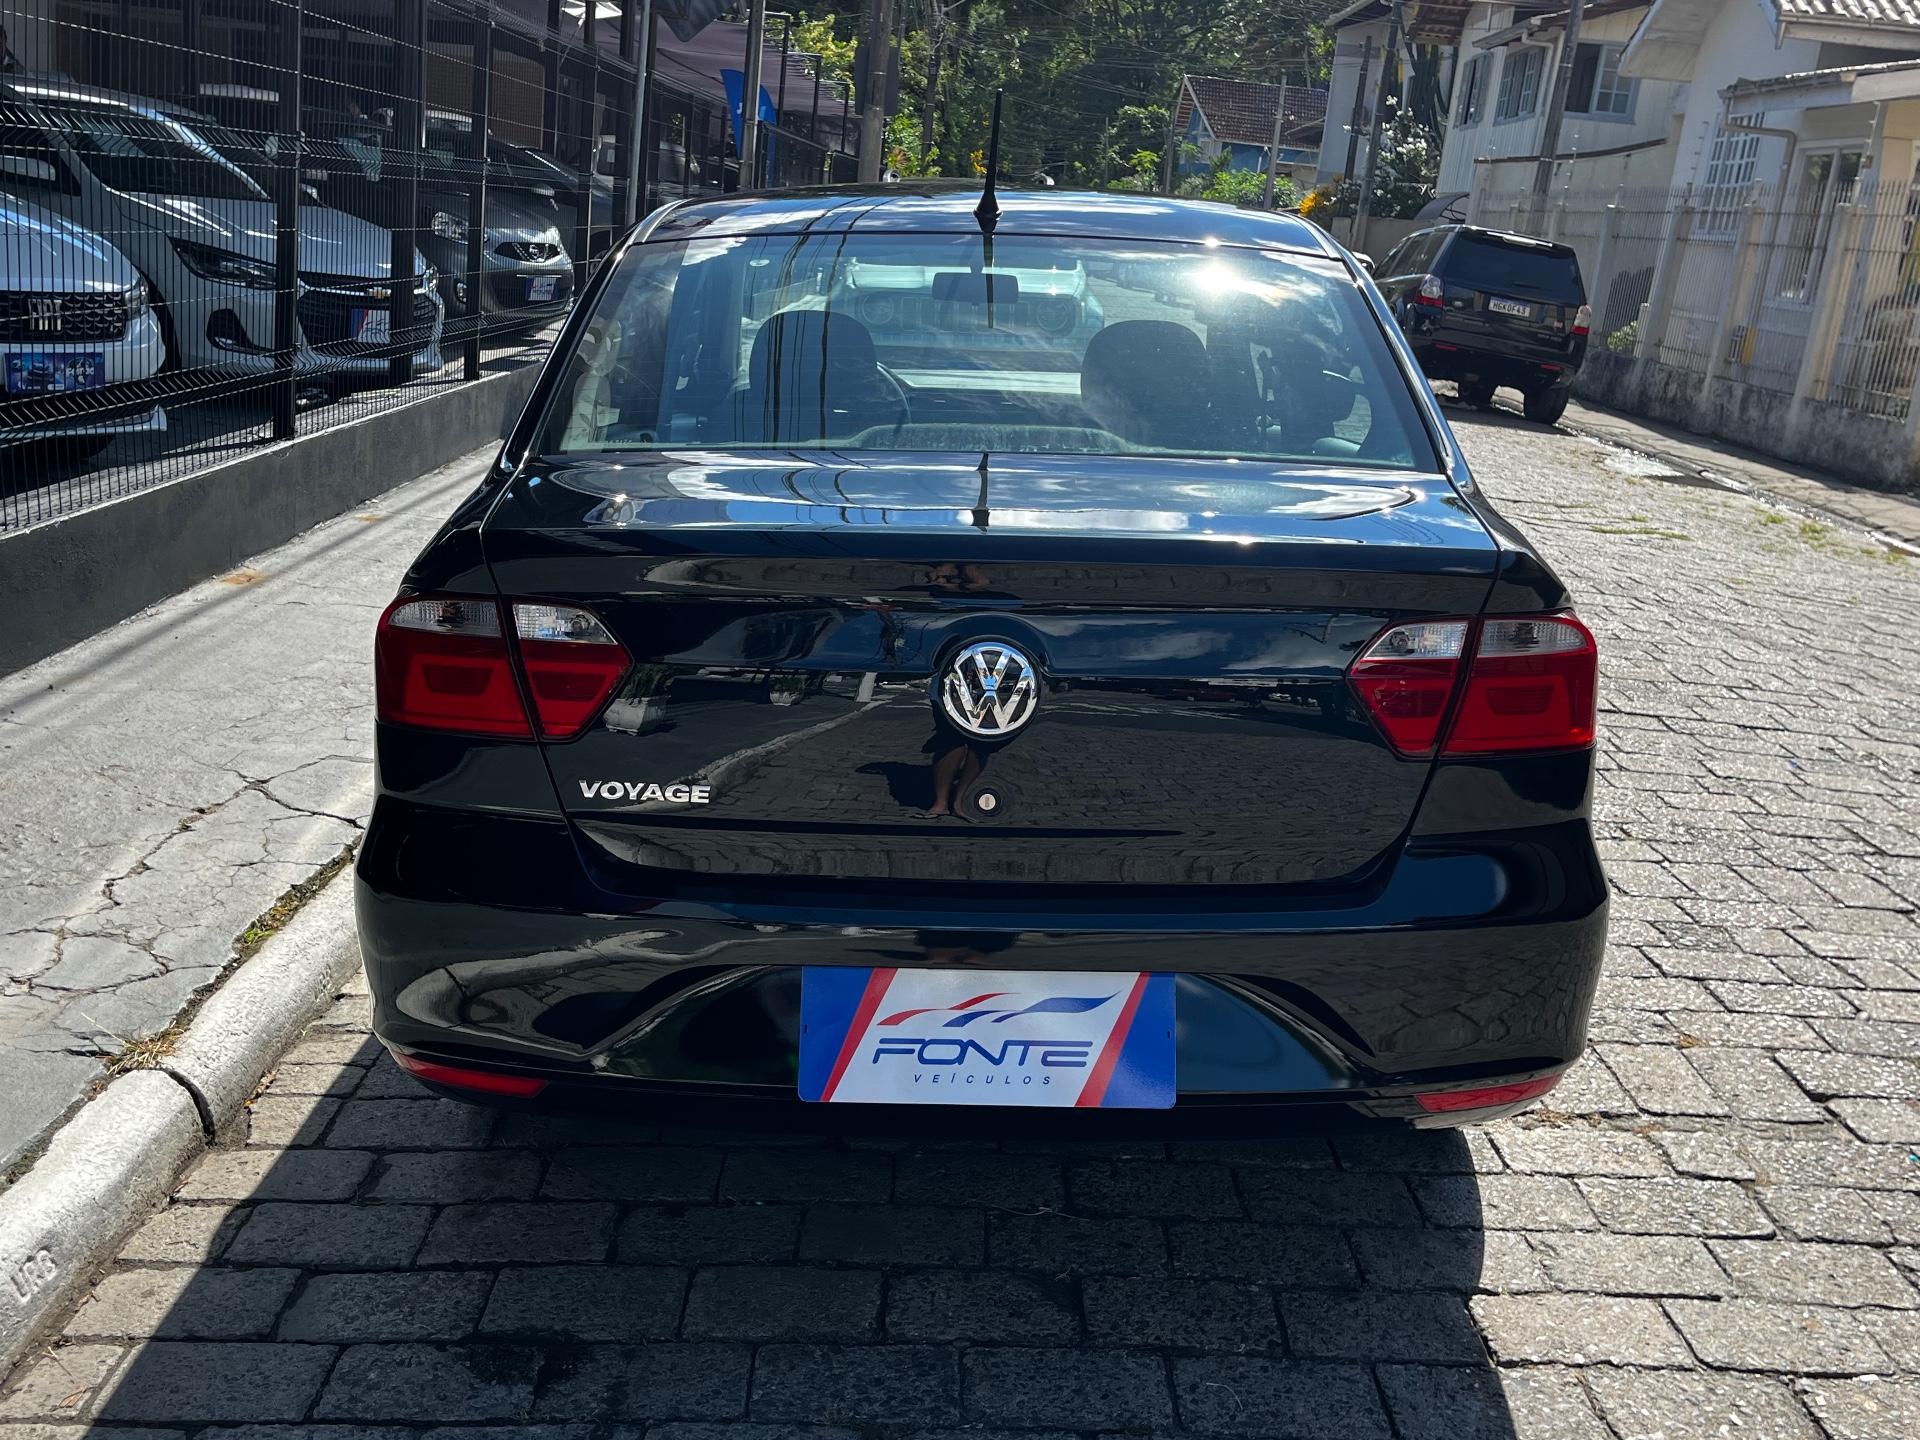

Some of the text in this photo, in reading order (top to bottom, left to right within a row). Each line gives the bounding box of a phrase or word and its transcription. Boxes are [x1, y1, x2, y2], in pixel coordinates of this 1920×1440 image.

[943, 641, 1038, 735] VW
[578, 779, 711, 803] VOYAGE
[872, 1037, 1093, 1068] FONTE
[913, 1071, 1053, 1086] VEÍCULOS
